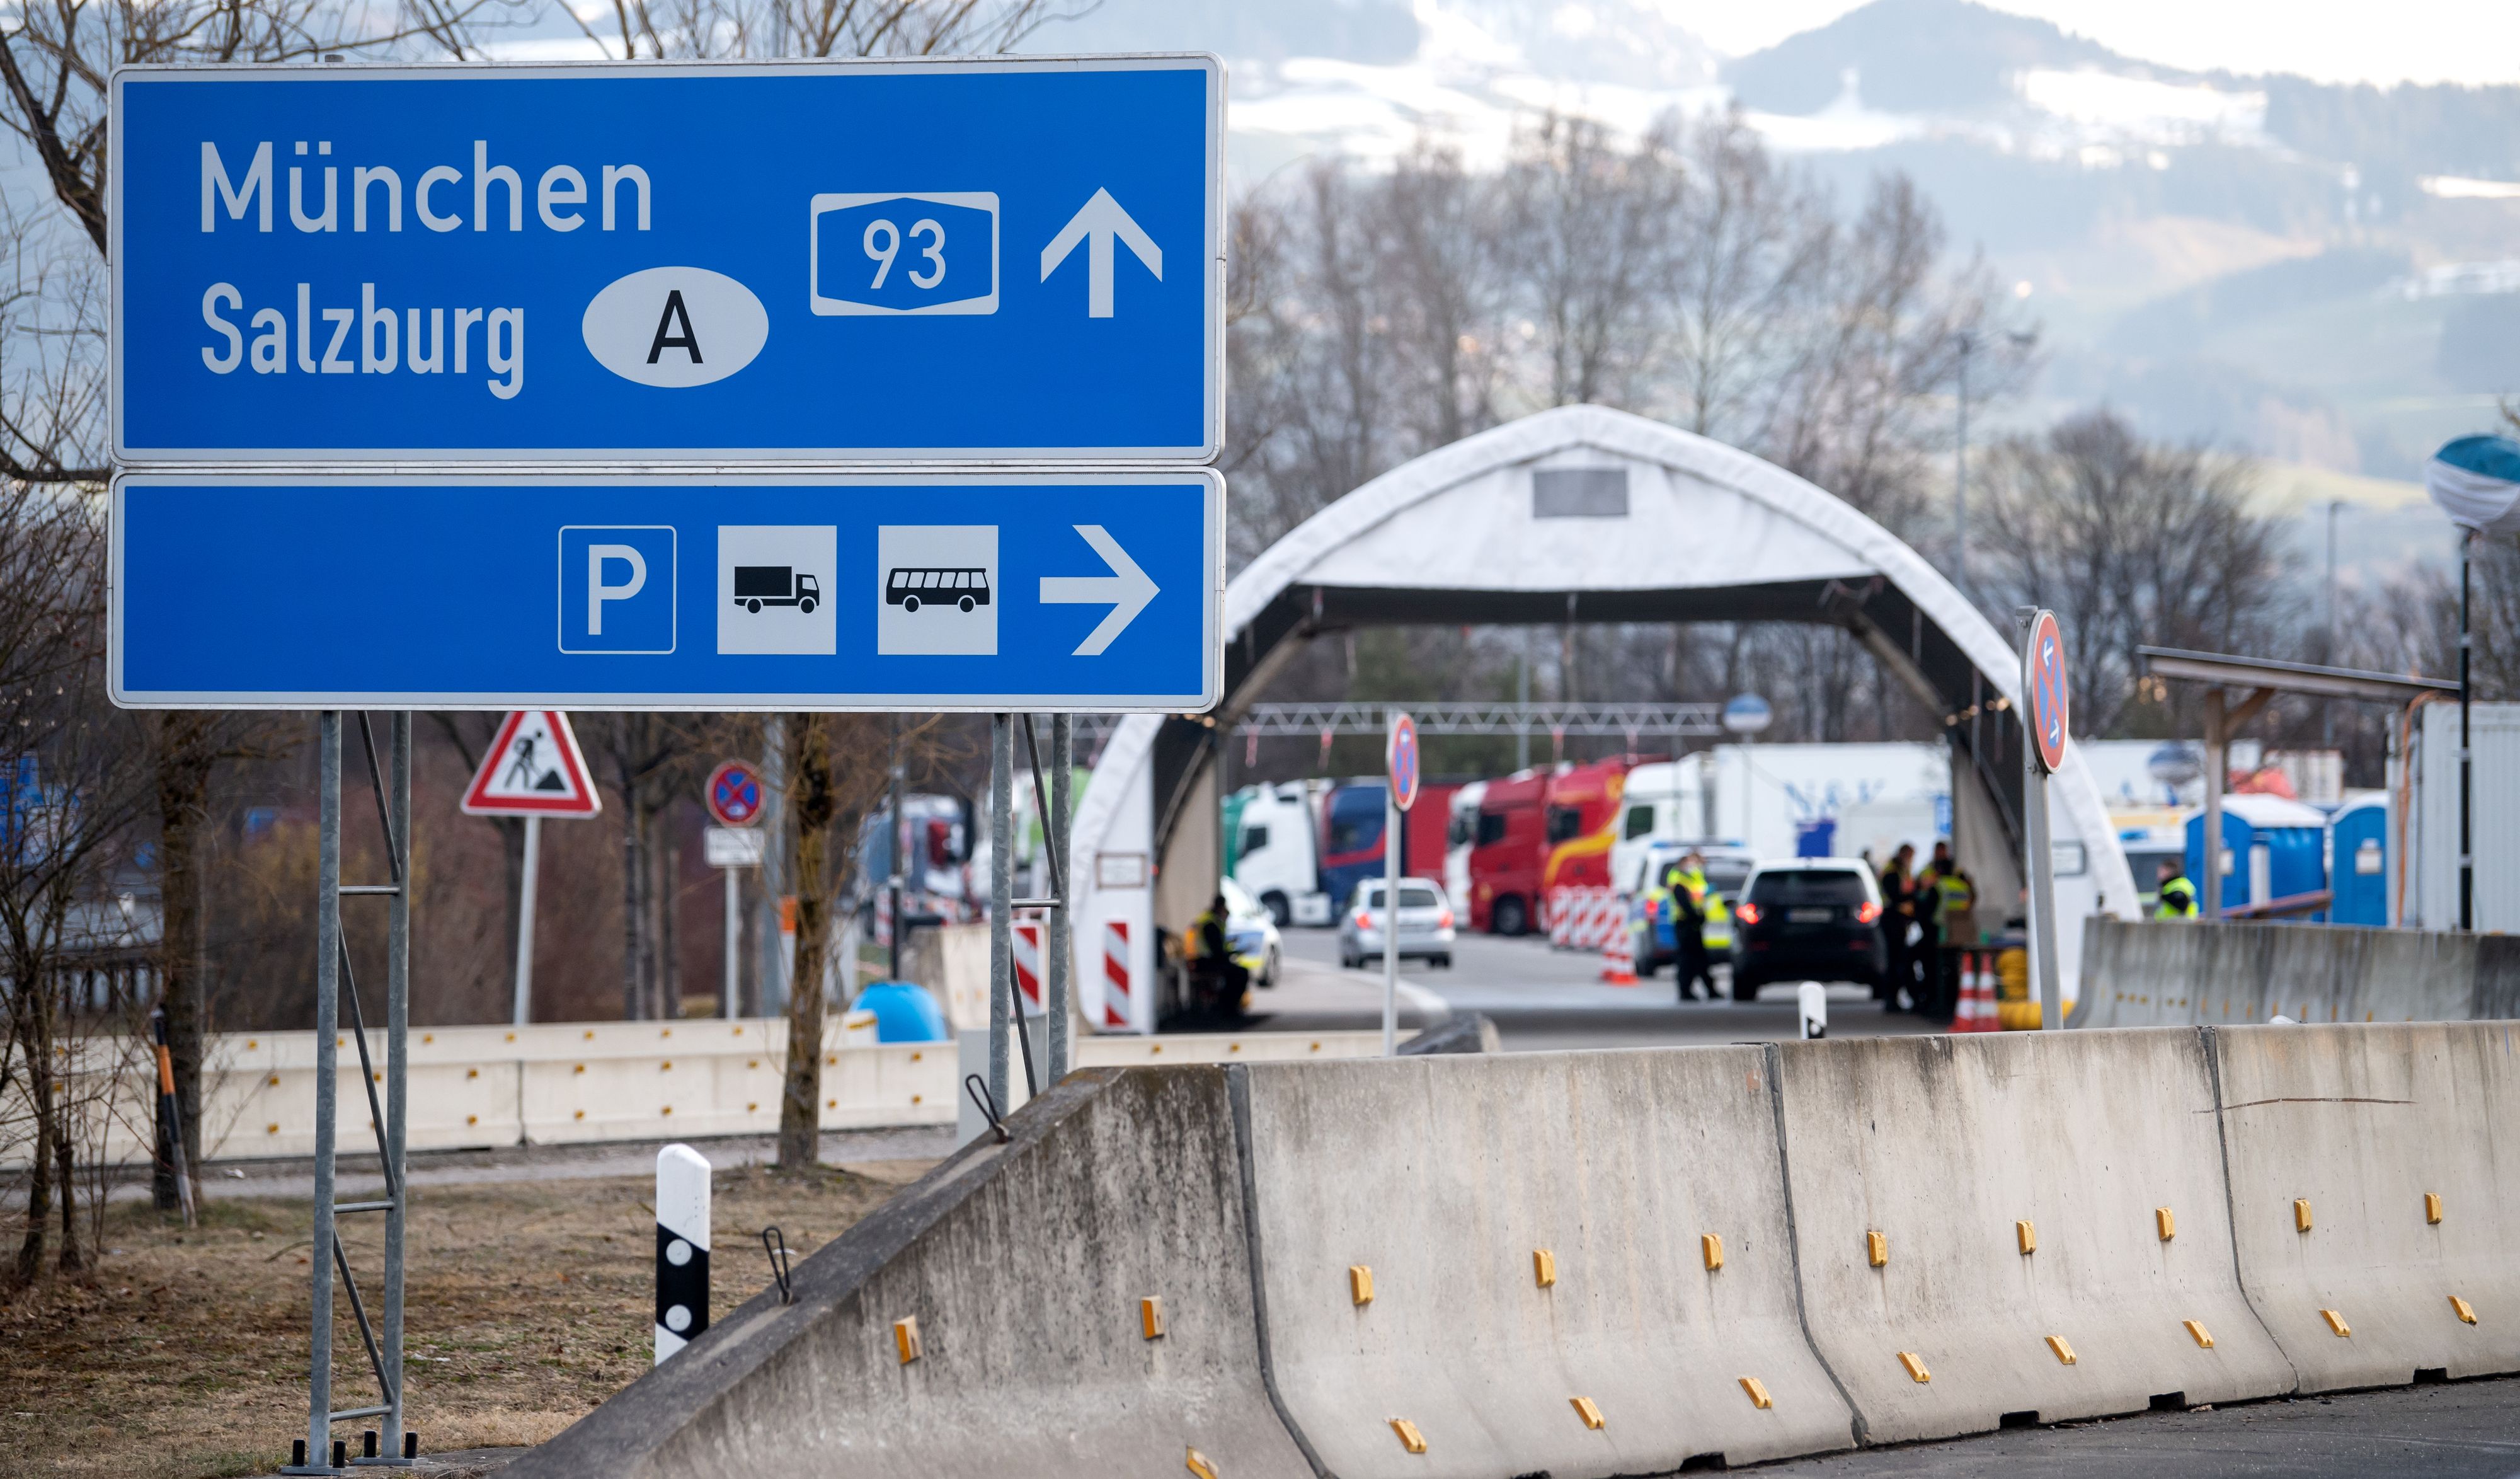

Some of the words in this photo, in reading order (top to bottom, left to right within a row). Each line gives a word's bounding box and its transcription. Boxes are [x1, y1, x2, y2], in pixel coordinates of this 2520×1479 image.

[201, 141, 651, 233] München
[863, 219, 946, 289] 93
[202, 282, 524, 400] Salzburg
[646, 290, 704, 364] A
[588, 544, 647, 635] P
